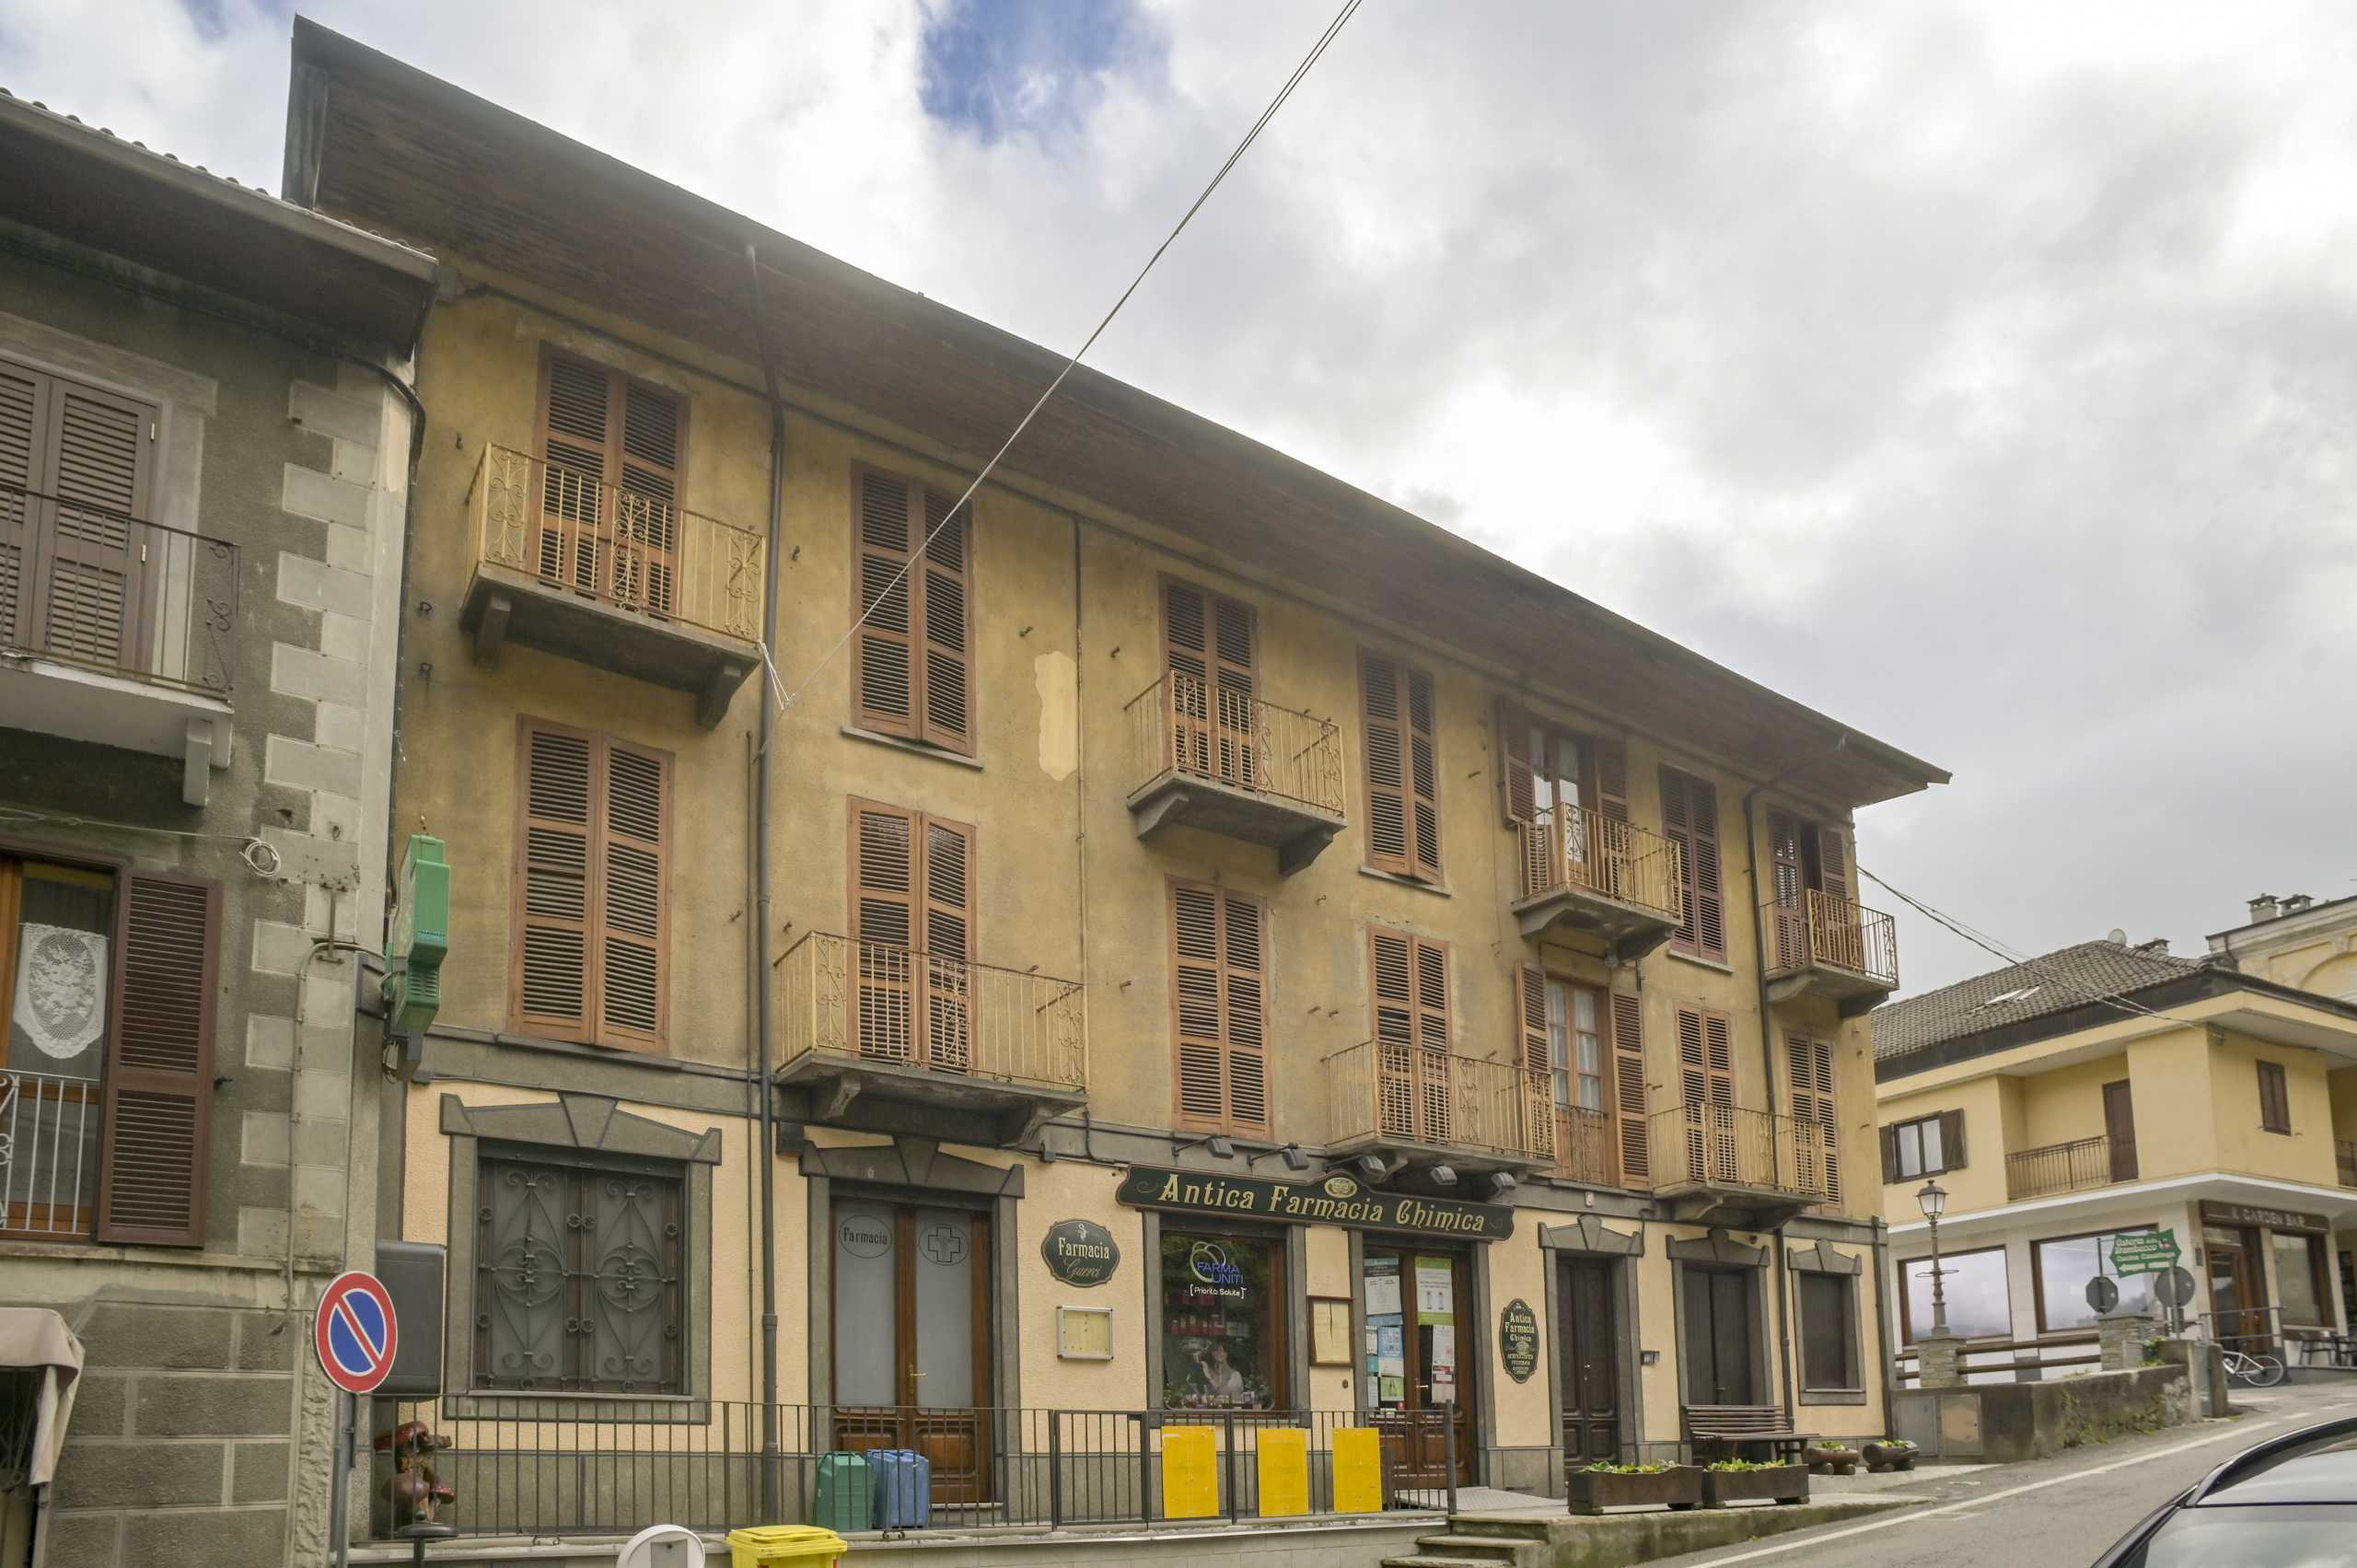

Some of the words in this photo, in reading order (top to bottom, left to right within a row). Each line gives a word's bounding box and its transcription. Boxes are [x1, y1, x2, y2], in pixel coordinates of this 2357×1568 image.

[1157, 1173, 1255, 1210] Antica
[1267, 1184, 1384, 1223] Farmacia
[1396, 1199, 1485, 1232] Chimica
[2243, 1208, 2283, 1225] GARDEN
[2285, 1214, 2305, 1228] BAR
[843, 1226, 888, 1245] Farmacia
[1058, 1237, 1110, 1260] Farmacia
[1197, 1261, 1241, 1274] FARMA
[1211, 1272, 1244, 1284] UNITI
[1510, 1311, 1531, 1323] Antica
[1504, 1321, 1535, 1334] Farmacia
[1509, 1333, 1532, 1342] Chimica
